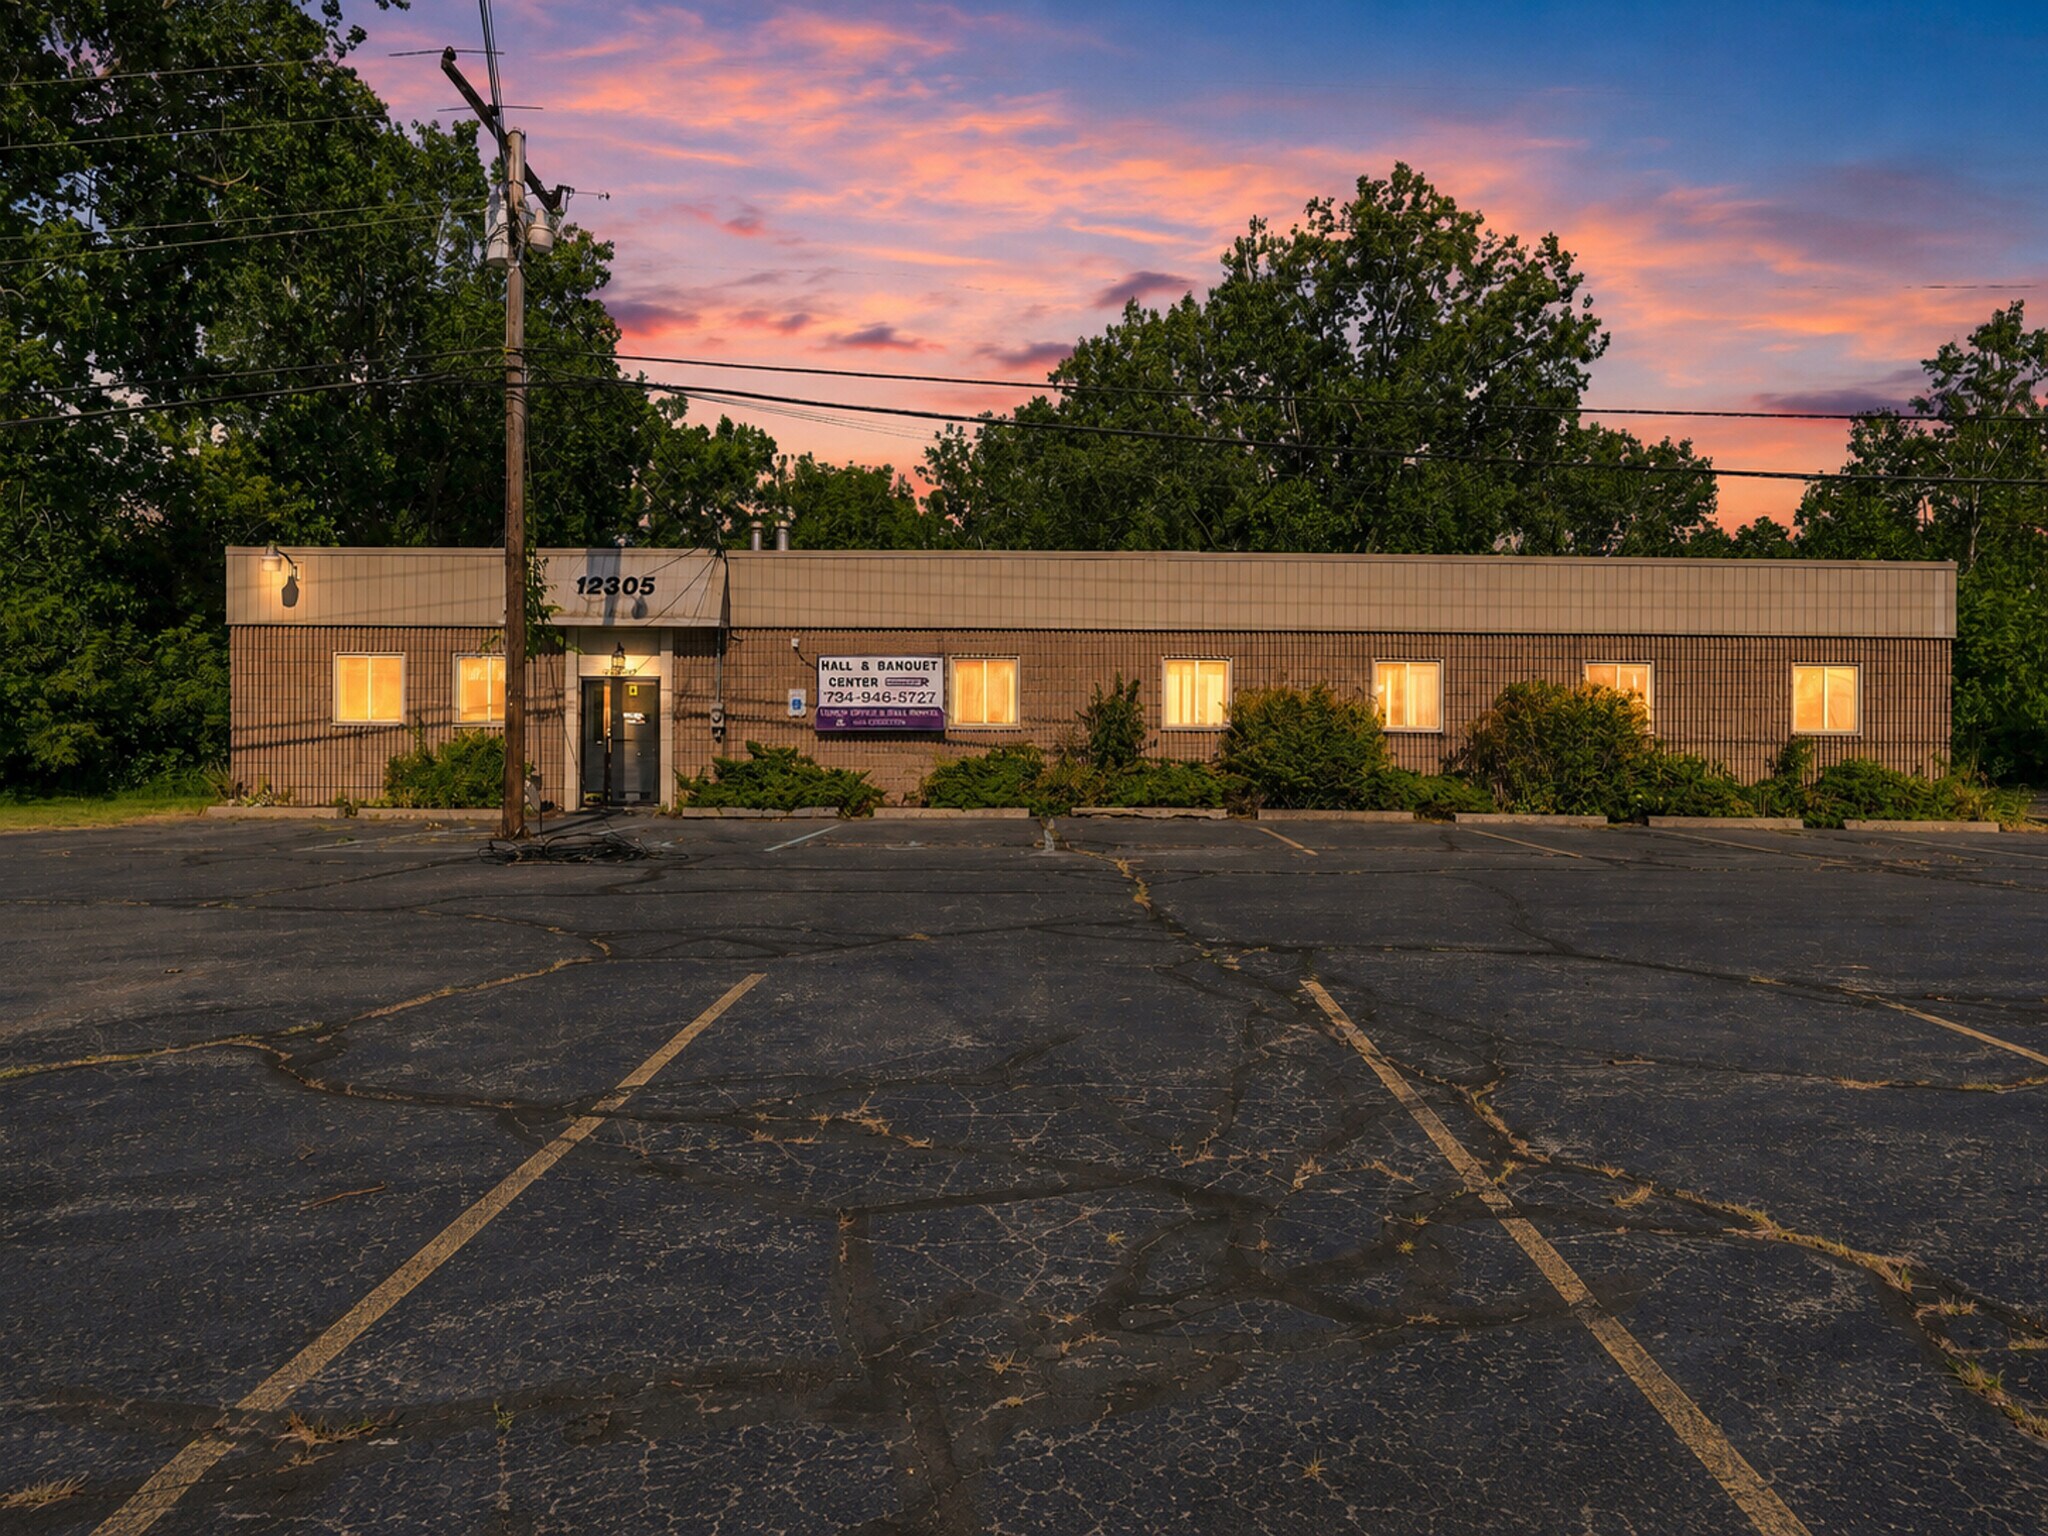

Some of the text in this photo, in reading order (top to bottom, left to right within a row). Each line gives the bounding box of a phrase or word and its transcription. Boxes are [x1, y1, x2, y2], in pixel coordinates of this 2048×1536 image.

[576, 576, 656, 596] 12305
[821, 660, 938, 671] HALL & BANQUET
[828, 677, 879, 688] CENTER
[823, 690, 936, 704] 734-946-5727
